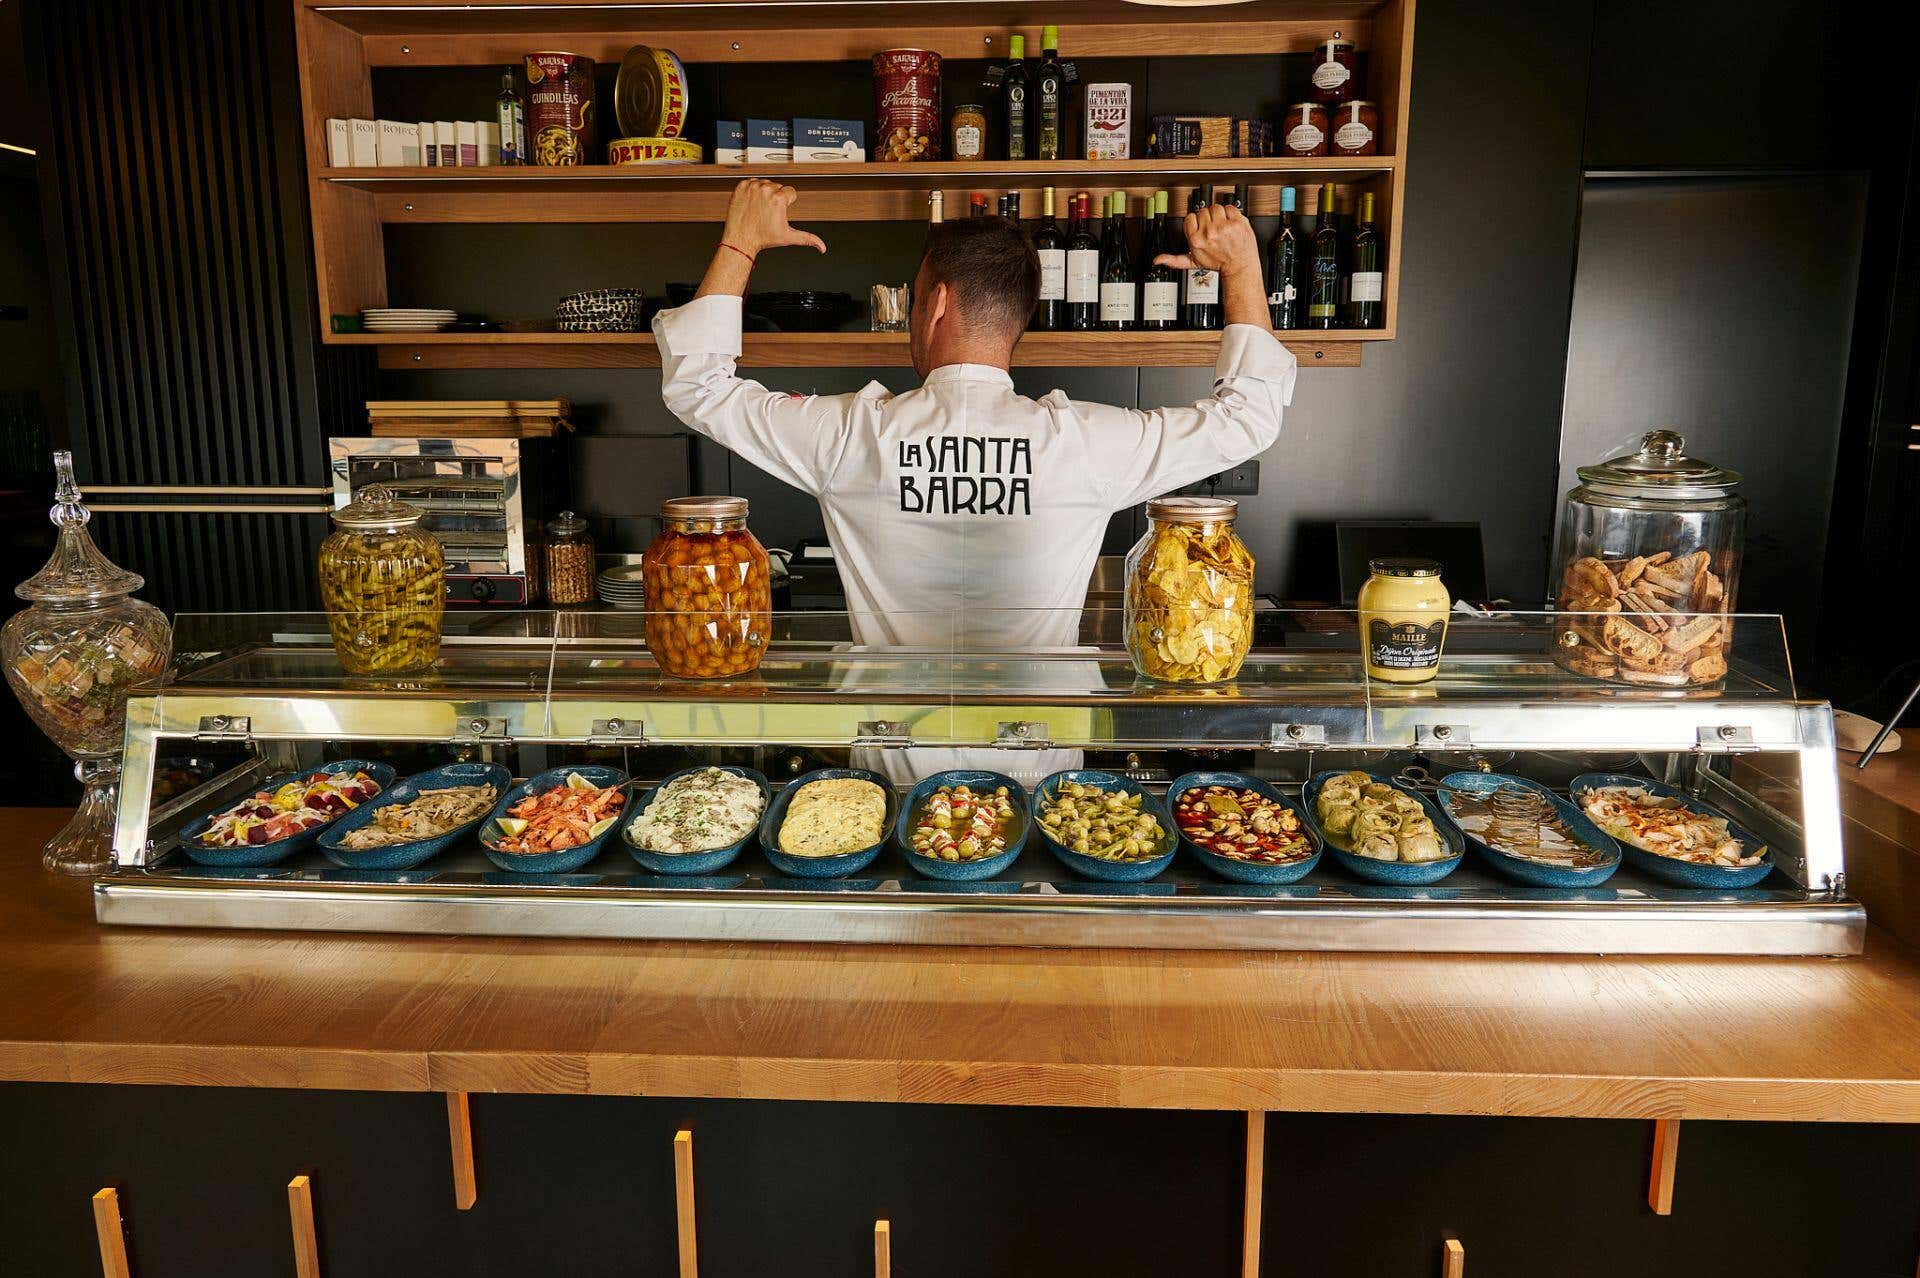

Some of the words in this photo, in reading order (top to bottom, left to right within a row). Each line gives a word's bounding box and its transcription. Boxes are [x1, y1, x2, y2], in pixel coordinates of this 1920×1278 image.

[663, 72, 682, 138] ORTIZ
[1089, 98, 1098, 106] DE
[1089, 108, 1127, 120] 1921
[807, 129, 821, 137] DON
[611, 146, 668, 166] ORTIZ
[899, 440, 922, 468] LA
[925, 436, 1032, 475] SANTA
[899, 476, 1032, 516] BARRA
[1391, 633, 1428, 642] MAILLE
